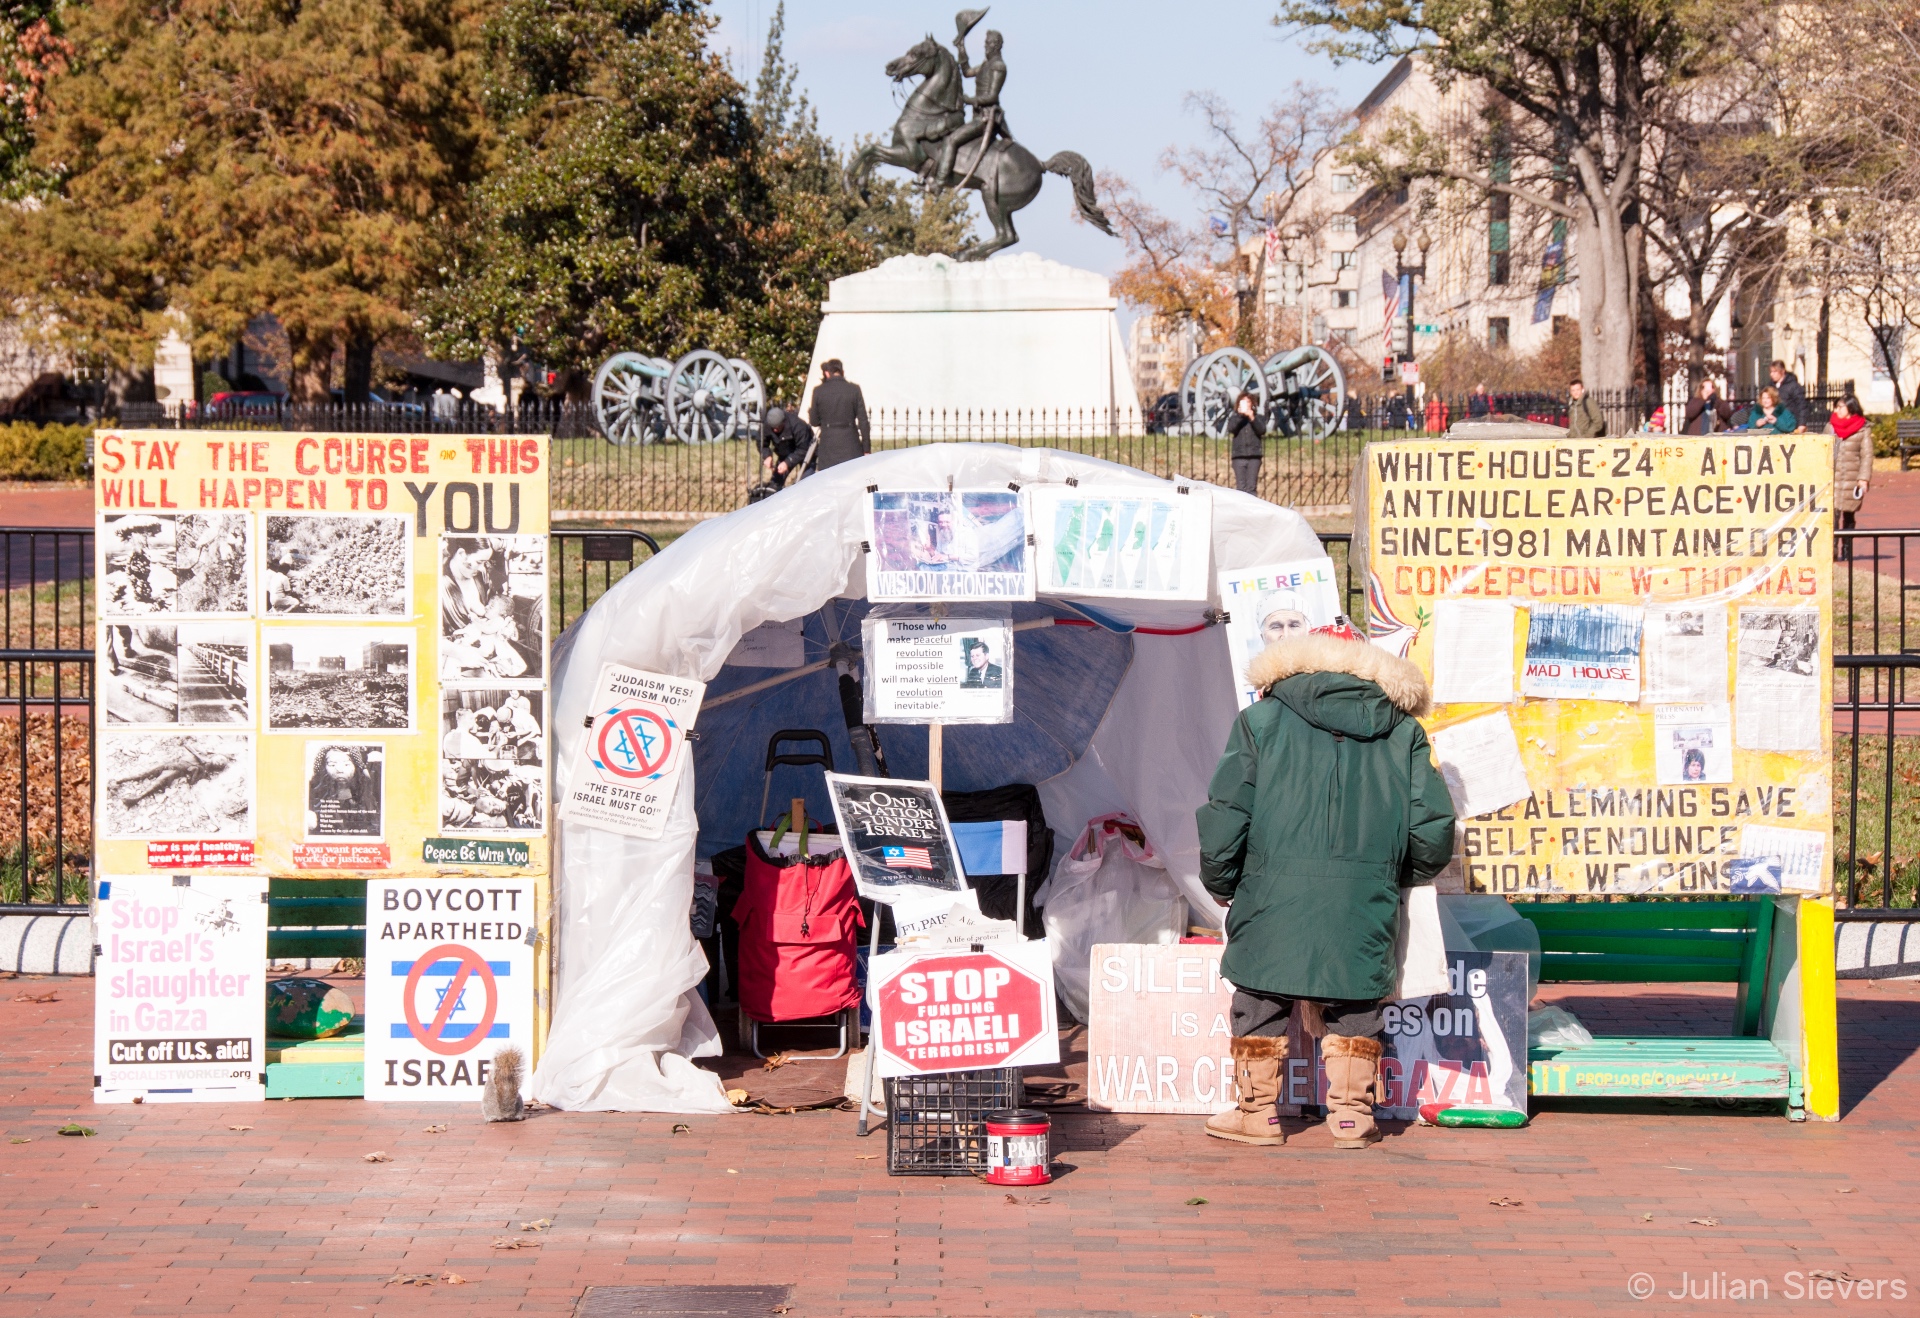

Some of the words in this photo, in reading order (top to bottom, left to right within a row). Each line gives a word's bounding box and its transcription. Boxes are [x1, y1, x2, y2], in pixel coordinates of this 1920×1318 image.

[101, 435, 180, 473] STAY
[206, 441, 270, 472] THE
[295, 437, 429, 475] COURSE
[464, 438, 540, 474] THIS
[1377, 450, 1475, 482] WHITE
[1488, 448, 1595, 479] HOUSE
[1611, 447, 1654, 478] 24
[1700, 446, 1717, 477] A
[1734, 444, 1796, 476] DAY
[101, 477, 178, 508] WILL
[199, 477, 327, 510] HAPPEN
[345, 478, 388, 511] TO
[403, 481, 520, 538] YOU
[1381, 487, 1614, 519] ANTINUCLEAR
[1624, 484, 1735, 517] PEACE
[1742, 482, 1828, 514] VIGIL
[1381, 526, 1475, 557] SINCE
[1481, 527, 1550, 559] 1981
[1566, 527, 1769, 558] MAINTAINED
[1777, 526, 1820, 558] BY
[877, 572, 938, 596] WISDOM
[952, 573, 1022, 596] HONESTY
[1228, 577, 1269, 594] THE
[1275, 569, 1329, 588] REAL
[1394, 564, 1601, 597] CONCEPCION
[1629, 566, 1653, 596] W
[1678, 565, 1817, 596] THOMAS
[926, 621, 947, 631] who
[886, 635, 911, 644] make
[913, 635, 953, 645] peaceful
[896, 649, 943, 658] revolution
[895, 662, 944, 671] impossible
[1525, 664, 1560, 677] MAD
[1572, 666, 1636, 681] HOUSE
[881, 675, 898, 684] will
[900, 675, 925, 684] make
[927, 675, 958, 684] violent
[609, 683, 658, 701] ZIONISM
[668, 684, 694, 698] YES!
[896, 688, 943, 698] revolution
[573, 791, 606, 806] ISRAEL
[608, 799, 637, 812] MUST
[610, 787, 642, 801] STATE
[644, 794, 657, 804] OF
[869, 791, 919, 808] ONE
[1523, 789, 1541, 820] A
[1546, 788, 1697, 818] LEMMING
[1711, 785, 1796, 817] SAVE
[849, 800, 934, 819] NATION
[861, 820, 933, 839] ISRAEL
[870, 815, 938, 830] UNDER
[148, 842, 169, 853] War
[170, 842, 180, 852] is
[182, 841, 200, 852] not
[202, 841, 250, 854] healthy...
[295, 844, 304, 854] If
[305, 846, 324, 855] you
[325, 845, 351, 854] want
[351, 845, 382, 856] peace,
[1464, 827, 1548, 857] SELF
[1561, 826, 1739, 856] RENOUNCE
[148, 852, 181, 863] aren't
[183, 854, 202, 864] you
[203, 853, 225, 863] sick
[226, 852, 239, 862] of
[240, 852, 256, 862] it?
[294, 854, 321, 863] work
[321, 854, 337, 863] for
[337, 854, 372, 865] justice.
[383, 888, 522, 912] BOYCOTT
[111, 899, 178, 936] Stop
[380, 922, 523, 940] APARTHEID
[946, 936, 953, 944] A
[954, 935, 965, 943] life
[975, 934, 999, 943] protest
[111, 932, 214, 963] Israel's
[1100, 956, 1237, 994] SILEN
[110, 967, 250, 1005] slaughter
[900, 967, 1010, 1005] STOP
[109, 1009, 130, 1032] in
[134, 1002, 207, 1032] Gaza
[917, 1001, 995, 1018] FUNDING
[895, 1013, 1019, 1046] ISRAELI
[1171, 1012, 1199, 1038] IS
[1207, 1013, 1231, 1038] A
[1432, 1004, 1474, 1037] on
[111, 1042, 144, 1062] Cut
[147, 1041, 174, 1061] off
[177, 1041, 212, 1061] U.S.
[215, 1040, 249, 1060] aid!
[906, 1041, 1010, 1060] TERRORISM
[109, 1068, 251, 1081] SOCIALISTWORKER.org
[384, 1058, 492, 1087] ISRAE
[1095, 1055, 1182, 1103] WAR
[1377, 1056, 1494, 1109] GAZA
